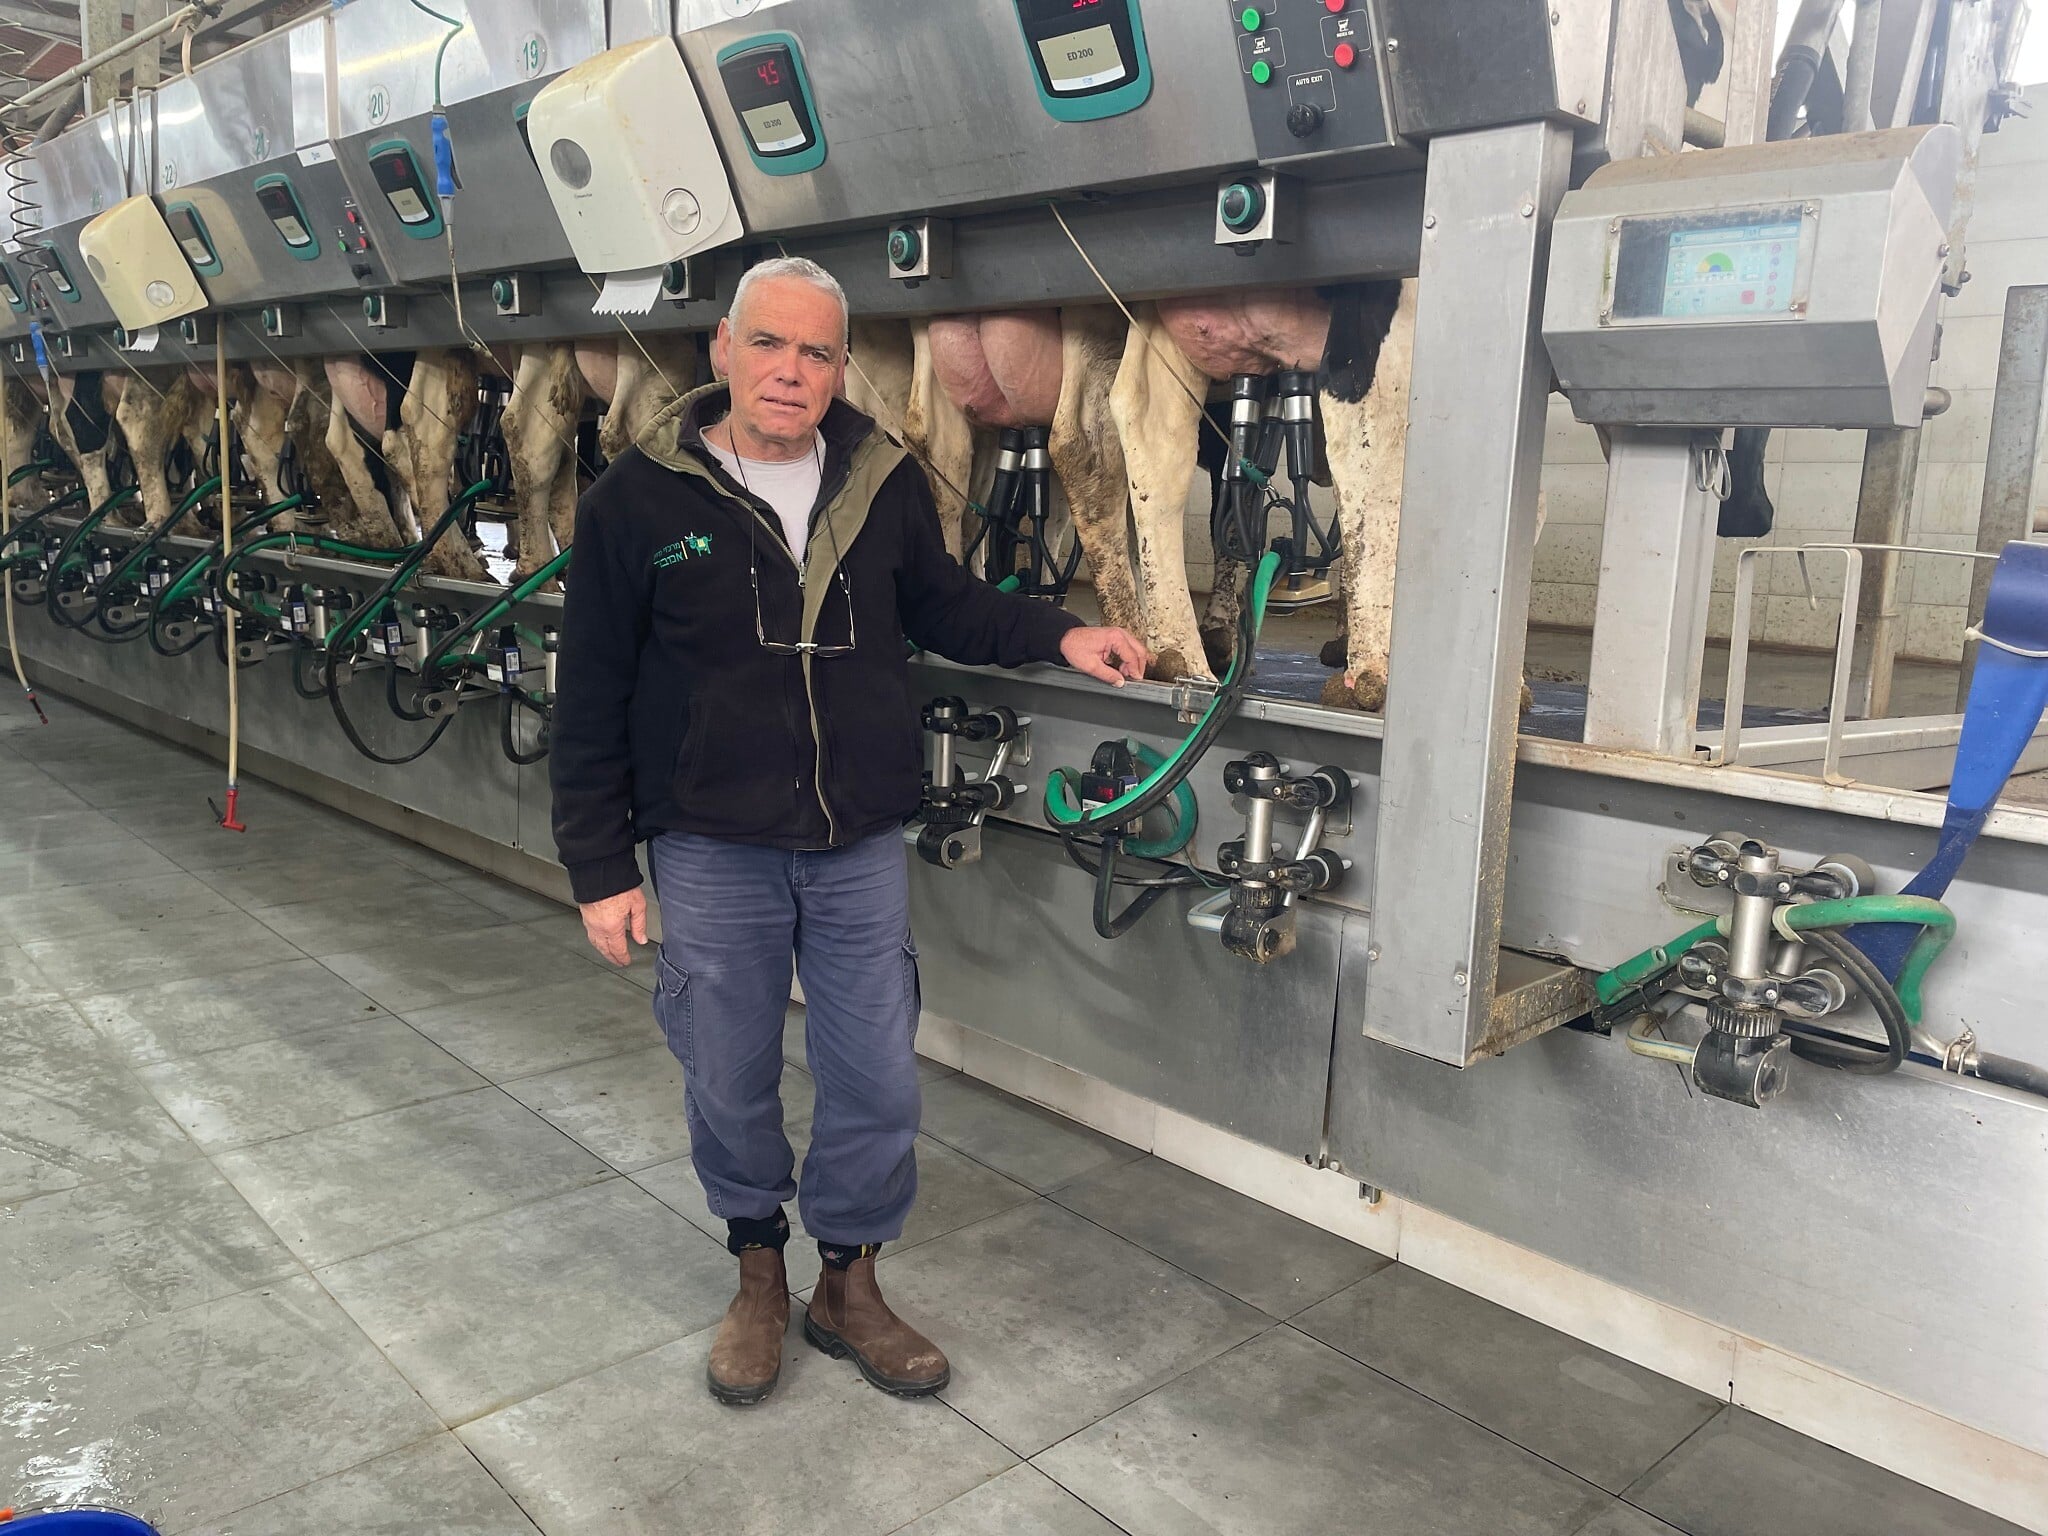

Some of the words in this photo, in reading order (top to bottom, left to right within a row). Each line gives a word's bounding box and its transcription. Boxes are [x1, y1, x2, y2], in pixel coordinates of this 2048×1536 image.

[523, 39, 539, 71] 19
[1295, 77, 1310, 86] AUTO
[1310, 75, 1323, 84] EXIT
[371, 92, 384, 119] 20
[164, 164, 174, 185] 22
